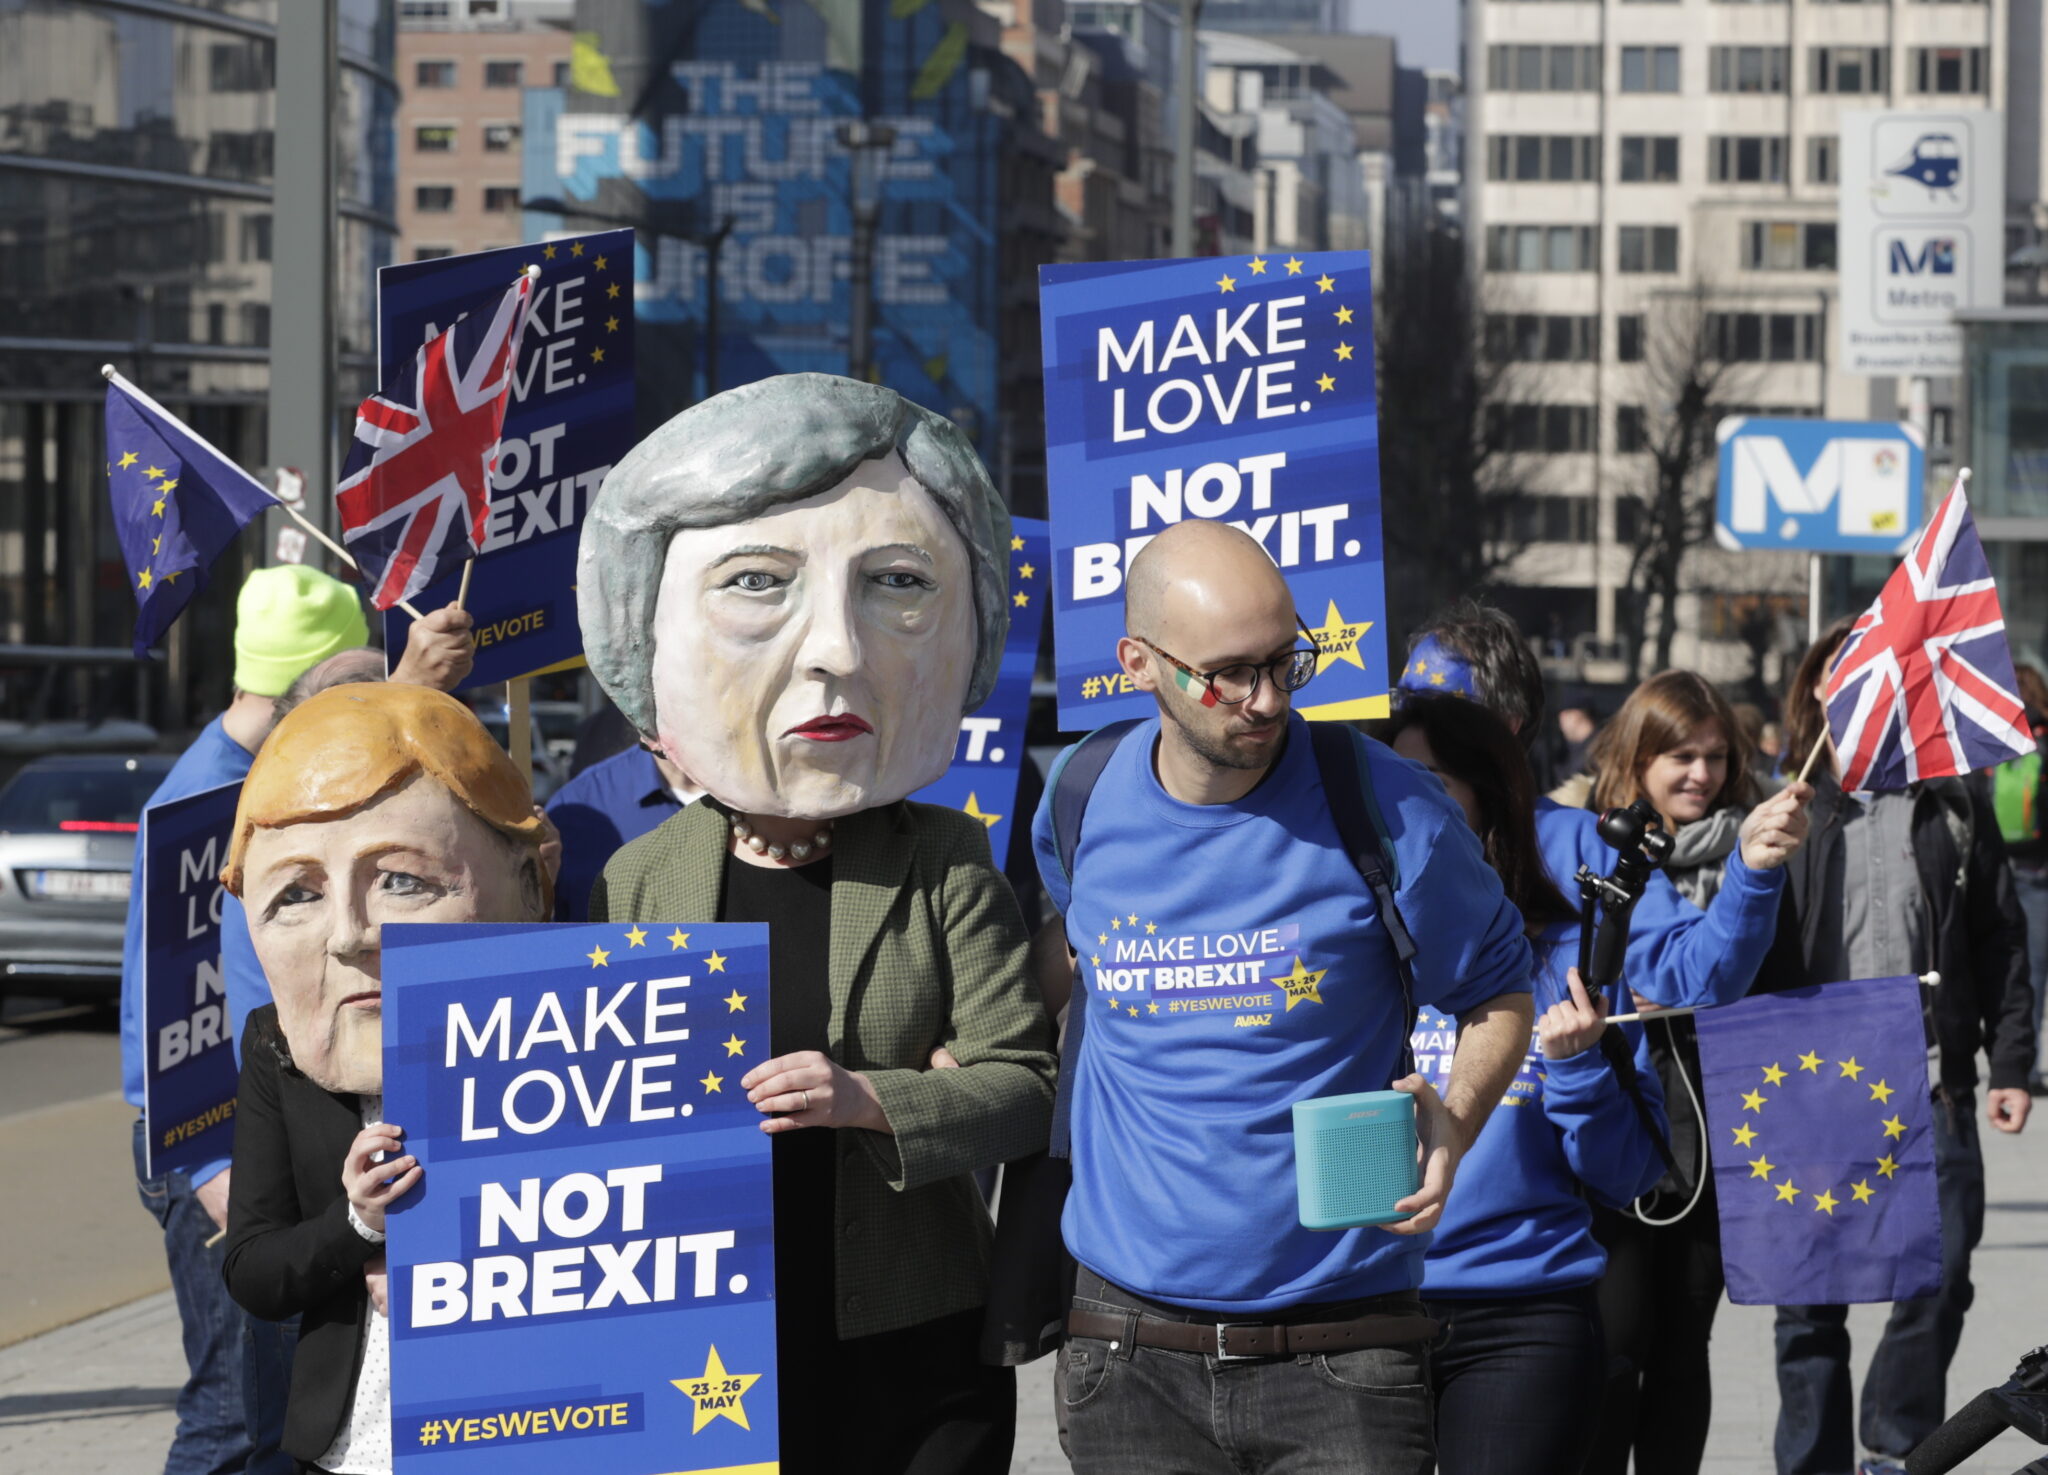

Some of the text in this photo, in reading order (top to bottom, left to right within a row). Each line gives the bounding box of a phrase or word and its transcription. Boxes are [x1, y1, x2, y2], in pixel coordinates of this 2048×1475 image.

[672, 61, 823, 113] THE
[555, 115, 934, 180] FUTURE
[712, 183, 776, 233] IS
[545, 231, 949, 303] UROPE
[425, 276, 586, 344] KE
[1098, 295, 1306, 382] MAKE
[511, 337, 586, 403] VE.
[1113, 360, 1312, 443] LOVE.
[489, 422, 566, 491] OT
[1130, 451, 1286, 530] NOT
[1314, 632, 1330, 643] 23
[1340, 627, 1357, 640] 26
[1322, 641, 1353, 655] MAY
[1115, 928, 1286, 963] MAKE LOVE.
[1095, 960, 1266, 992] NOT BREXIT
[1283, 978, 1296, 989] 23
[1303, 974, 1317, 986] 26
[1289, 985, 1313, 998] MAY
[444, 975, 692, 1068] MAKE
[1233, 1013, 1273, 1028] AVAAZ
[163, 1097, 238, 1149] #YESWE
[461, 1053, 694, 1142] LOVE.
[478, 1164, 663, 1248] NOT
[410, 1229, 749, 1329] BREXIT.
[690, 1383, 709, 1396] 23
[722, 1379, 742, 1392] 26
[699, 1395, 738, 1412] MAY
[418, 1402, 629, 1447] #YESWEVOTE
